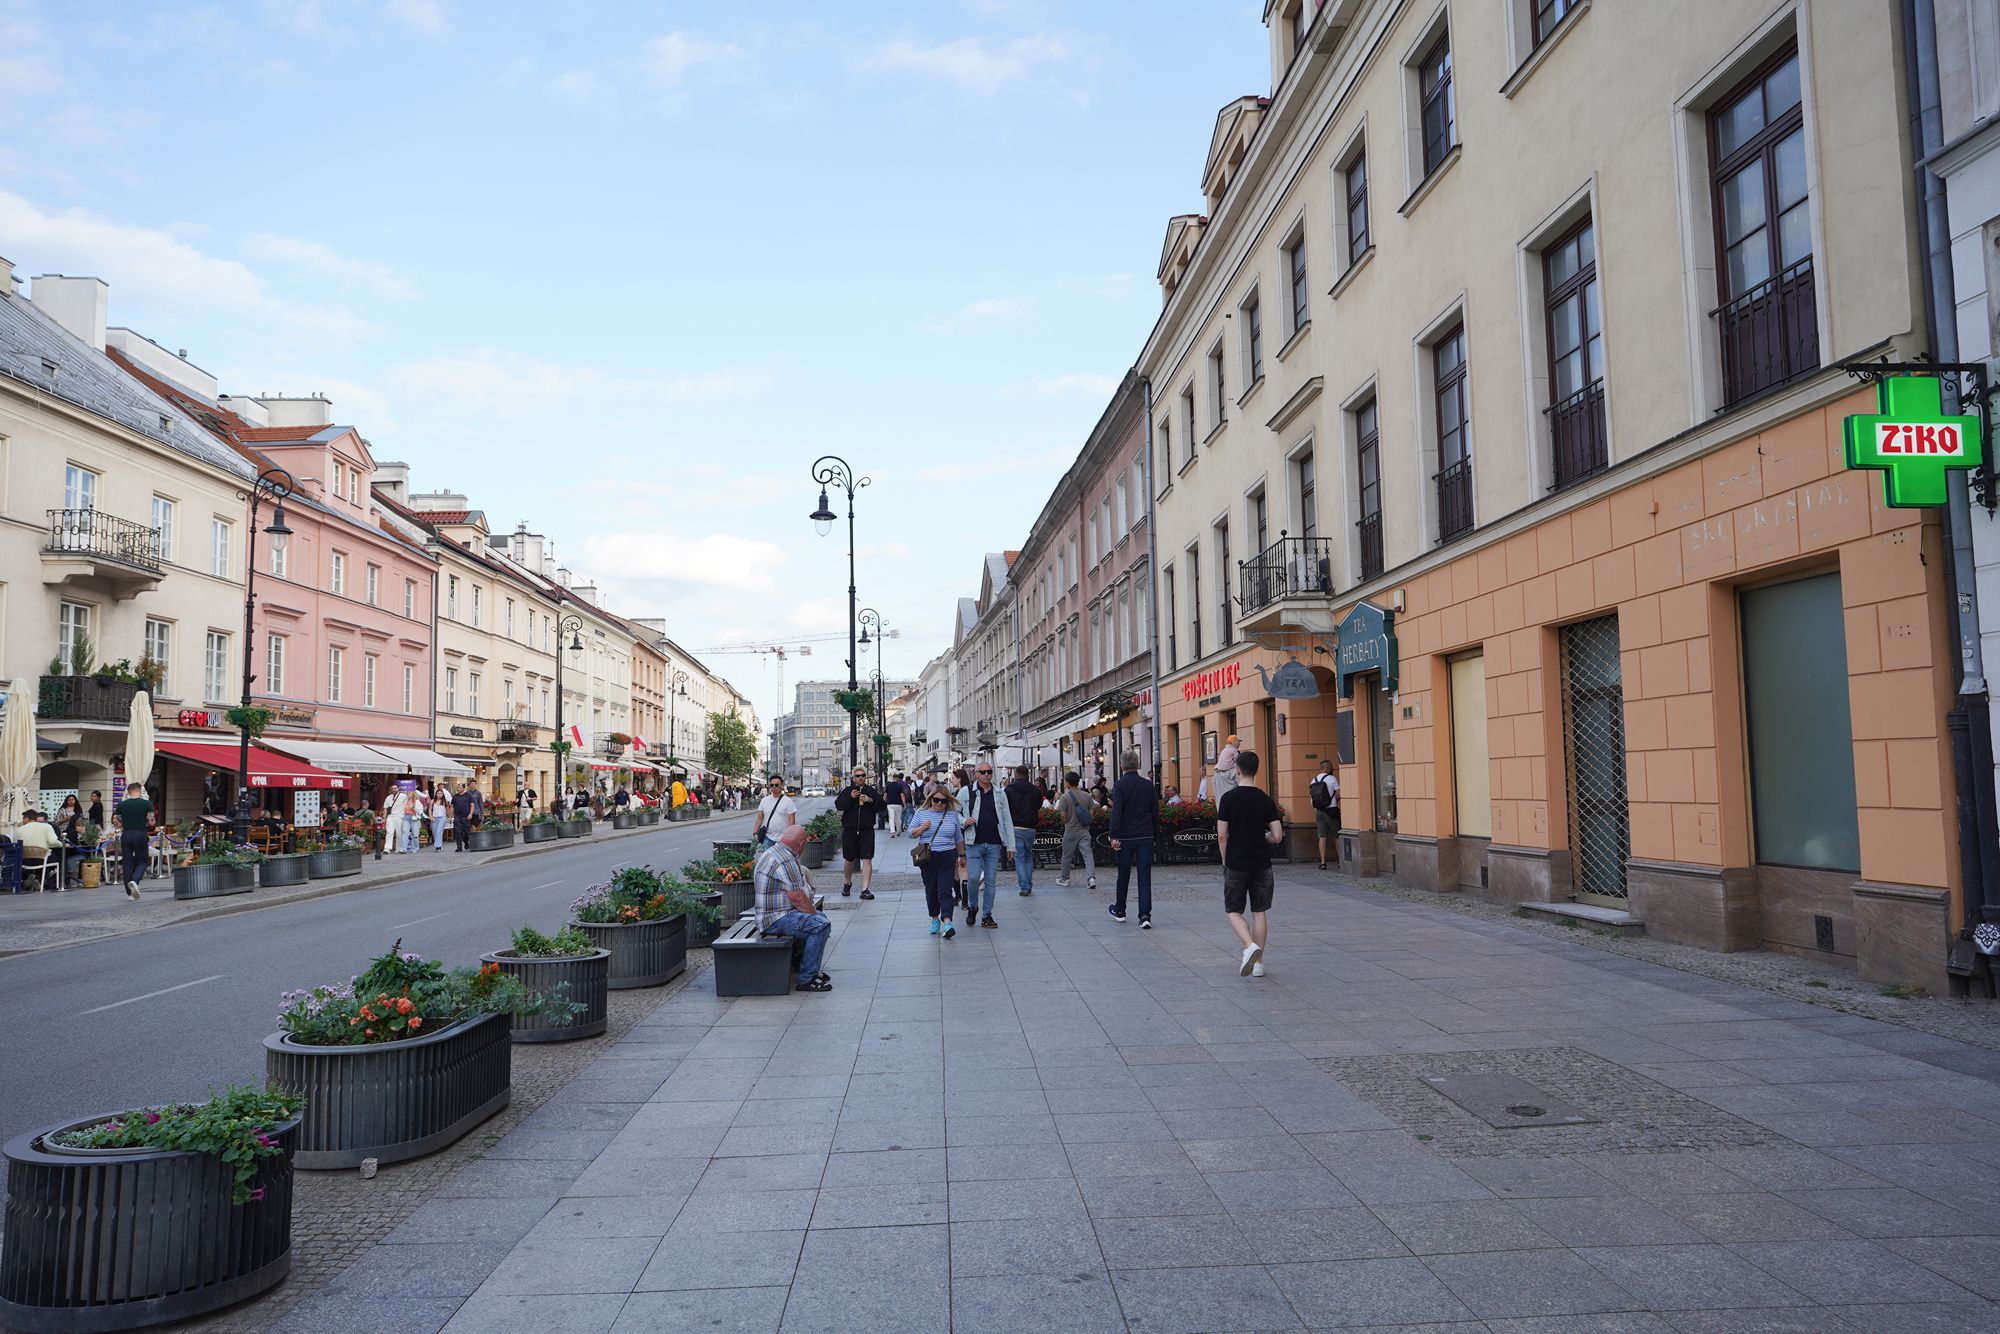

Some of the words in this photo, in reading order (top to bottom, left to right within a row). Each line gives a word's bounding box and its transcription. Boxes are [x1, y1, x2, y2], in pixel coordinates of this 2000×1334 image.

[1881, 424, 1959, 454] ZiKO
[1353, 616, 1367, 633] TEA
[1341, 635, 1382, 666] HERBATY
[1183, 662, 1240, 701] GOŚCINIEC
[1285, 679, 1306, 689] TEA
